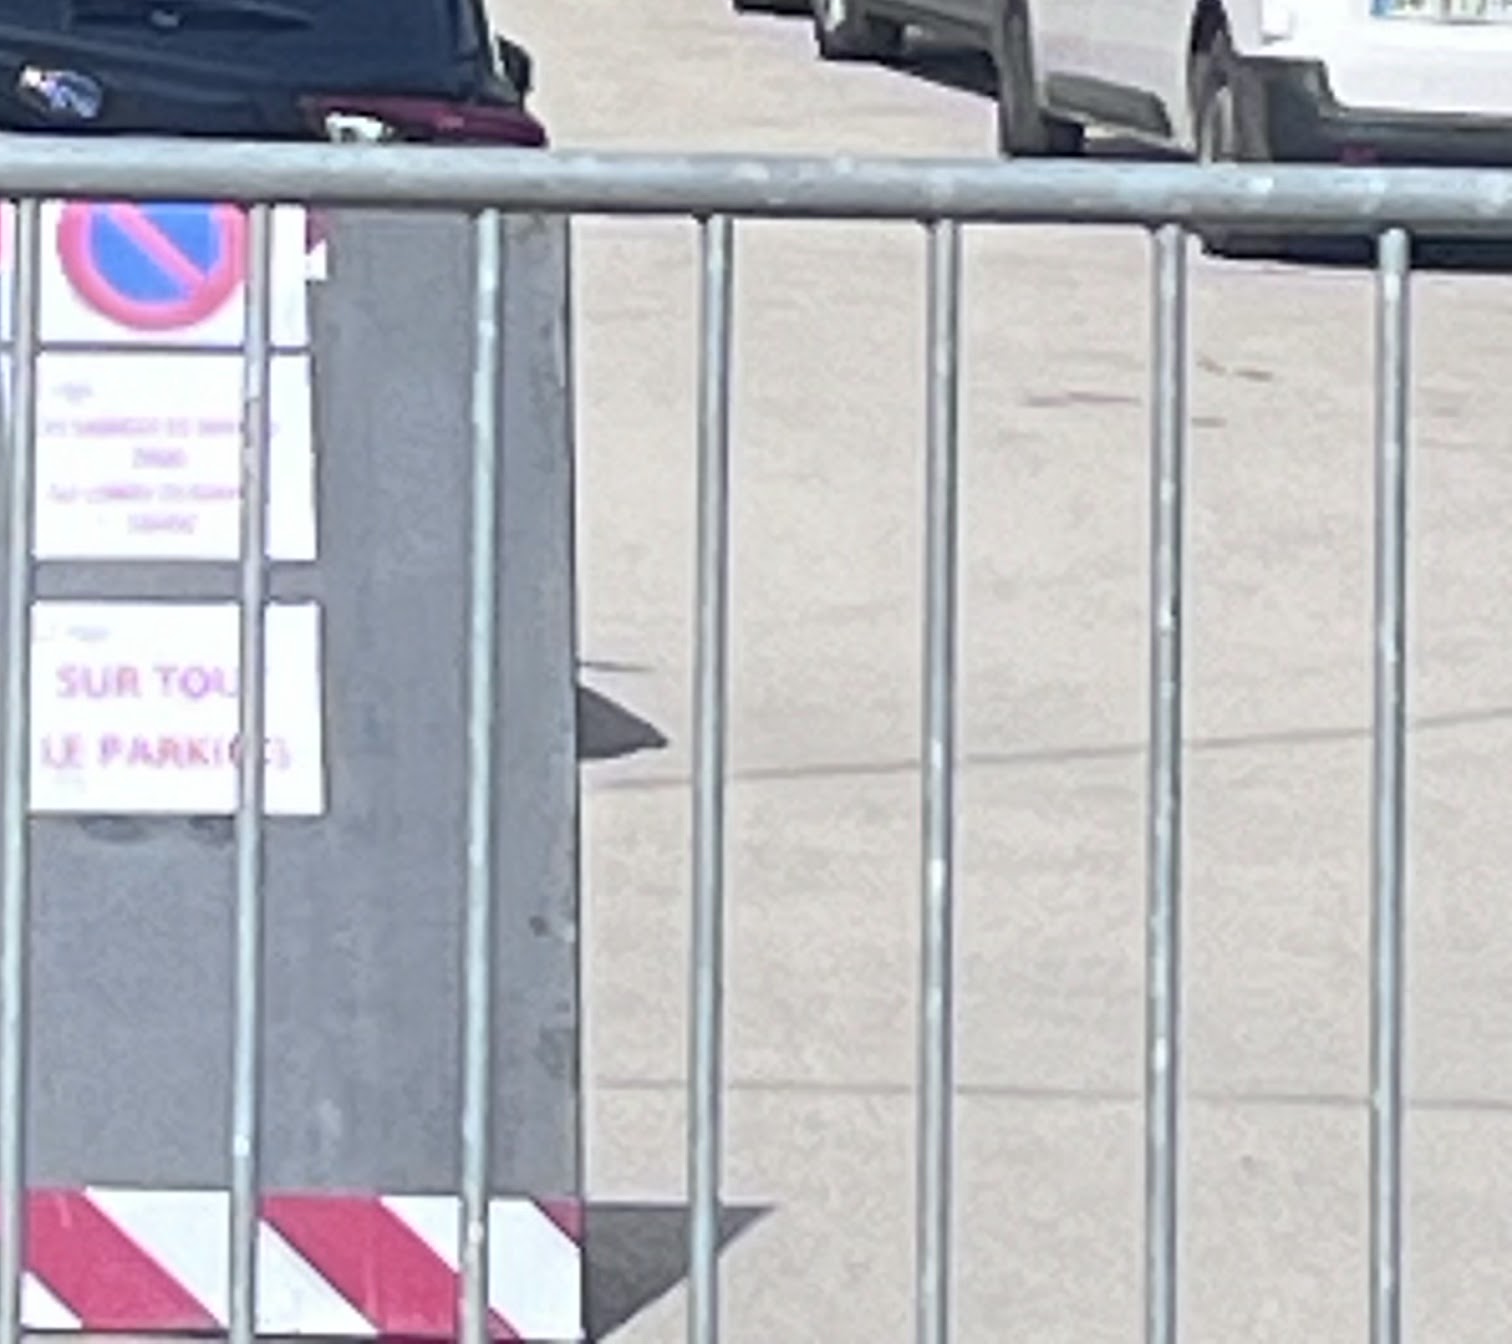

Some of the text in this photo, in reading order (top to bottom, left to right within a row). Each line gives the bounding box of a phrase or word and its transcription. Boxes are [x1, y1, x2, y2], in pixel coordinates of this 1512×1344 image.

[56, 663, 267, 701] SUR TOU
[40, 732, 85, 770] LE
